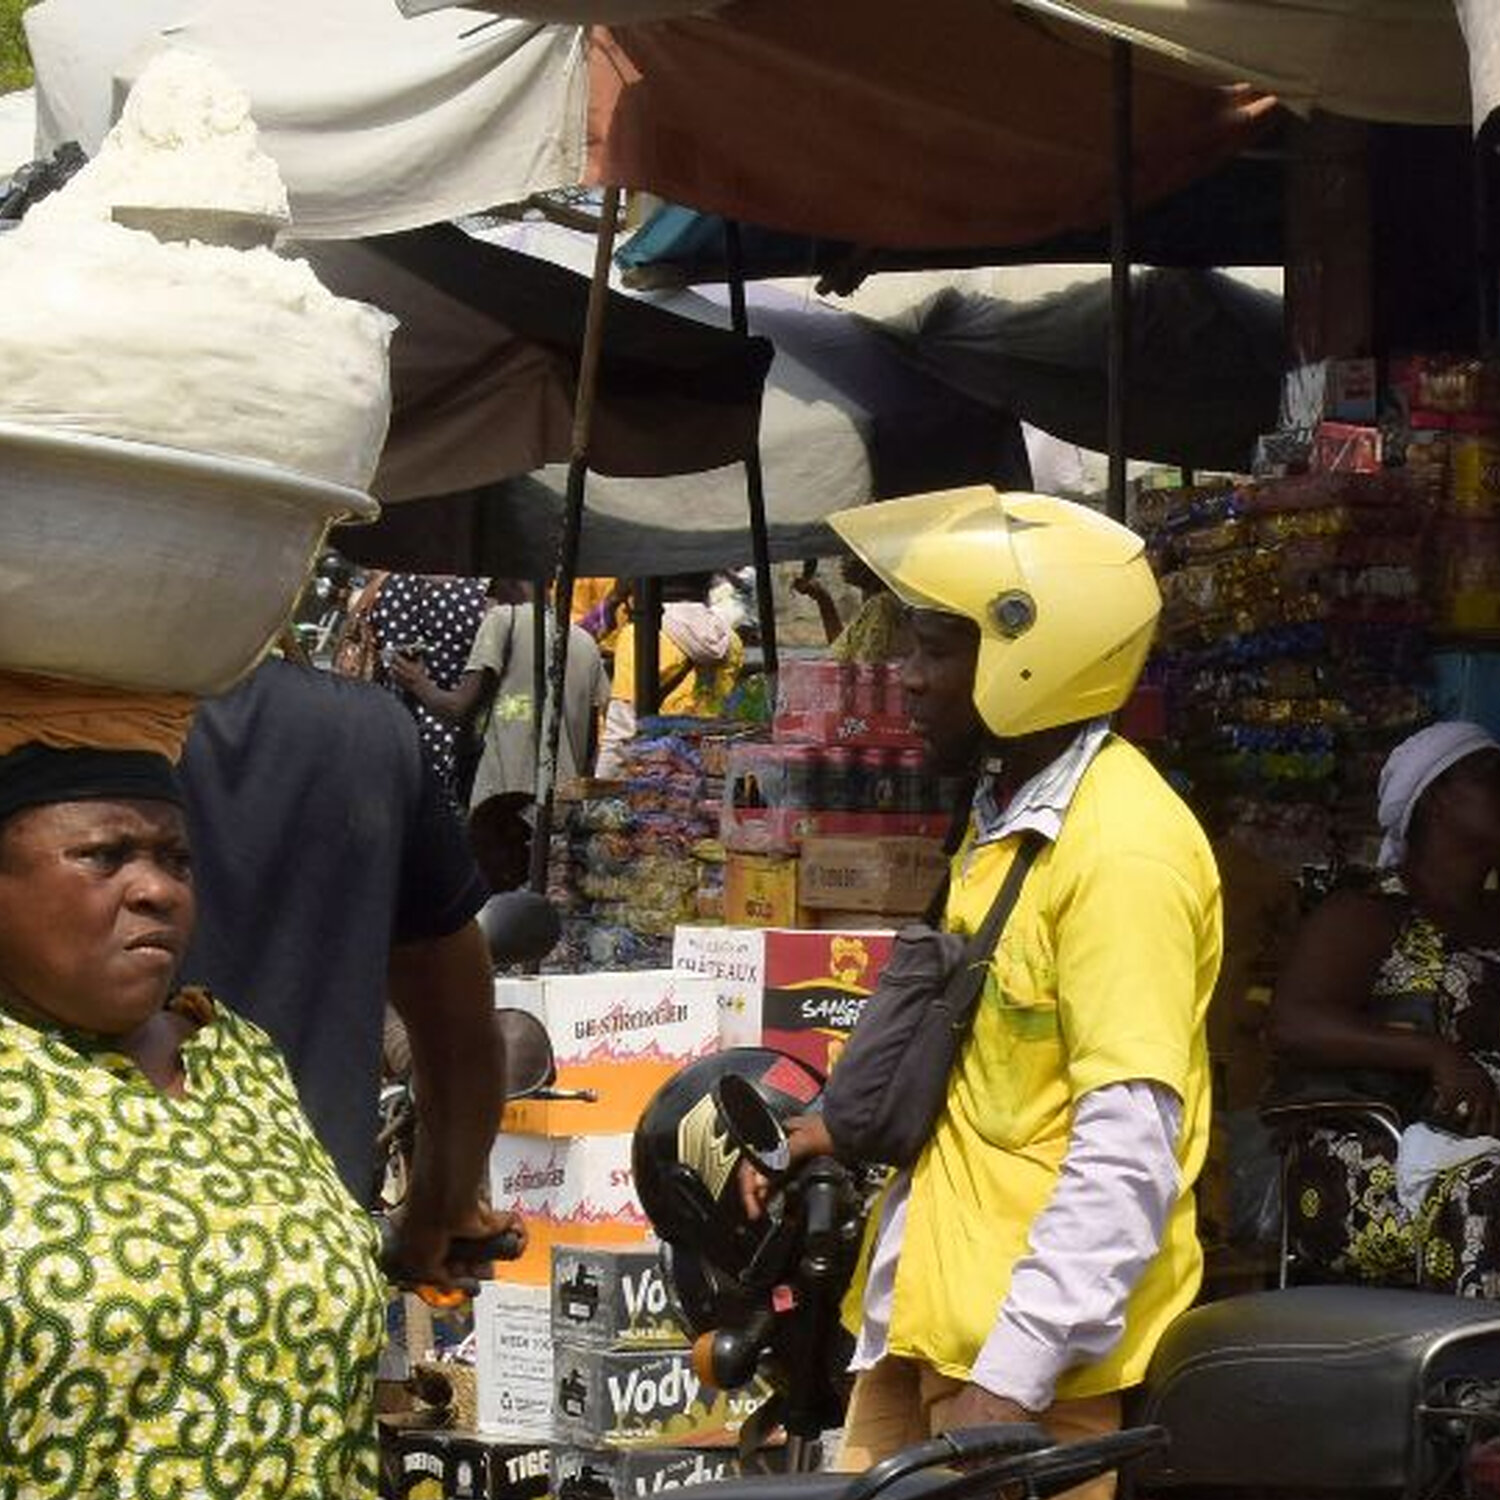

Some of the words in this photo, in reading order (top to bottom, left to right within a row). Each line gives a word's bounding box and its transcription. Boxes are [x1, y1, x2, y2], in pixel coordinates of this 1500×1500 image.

[621, 1268, 668, 1314] Vo
[608, 1357, 700, 1415] Vody
[505, 1450, 550, 1484] TIGE
